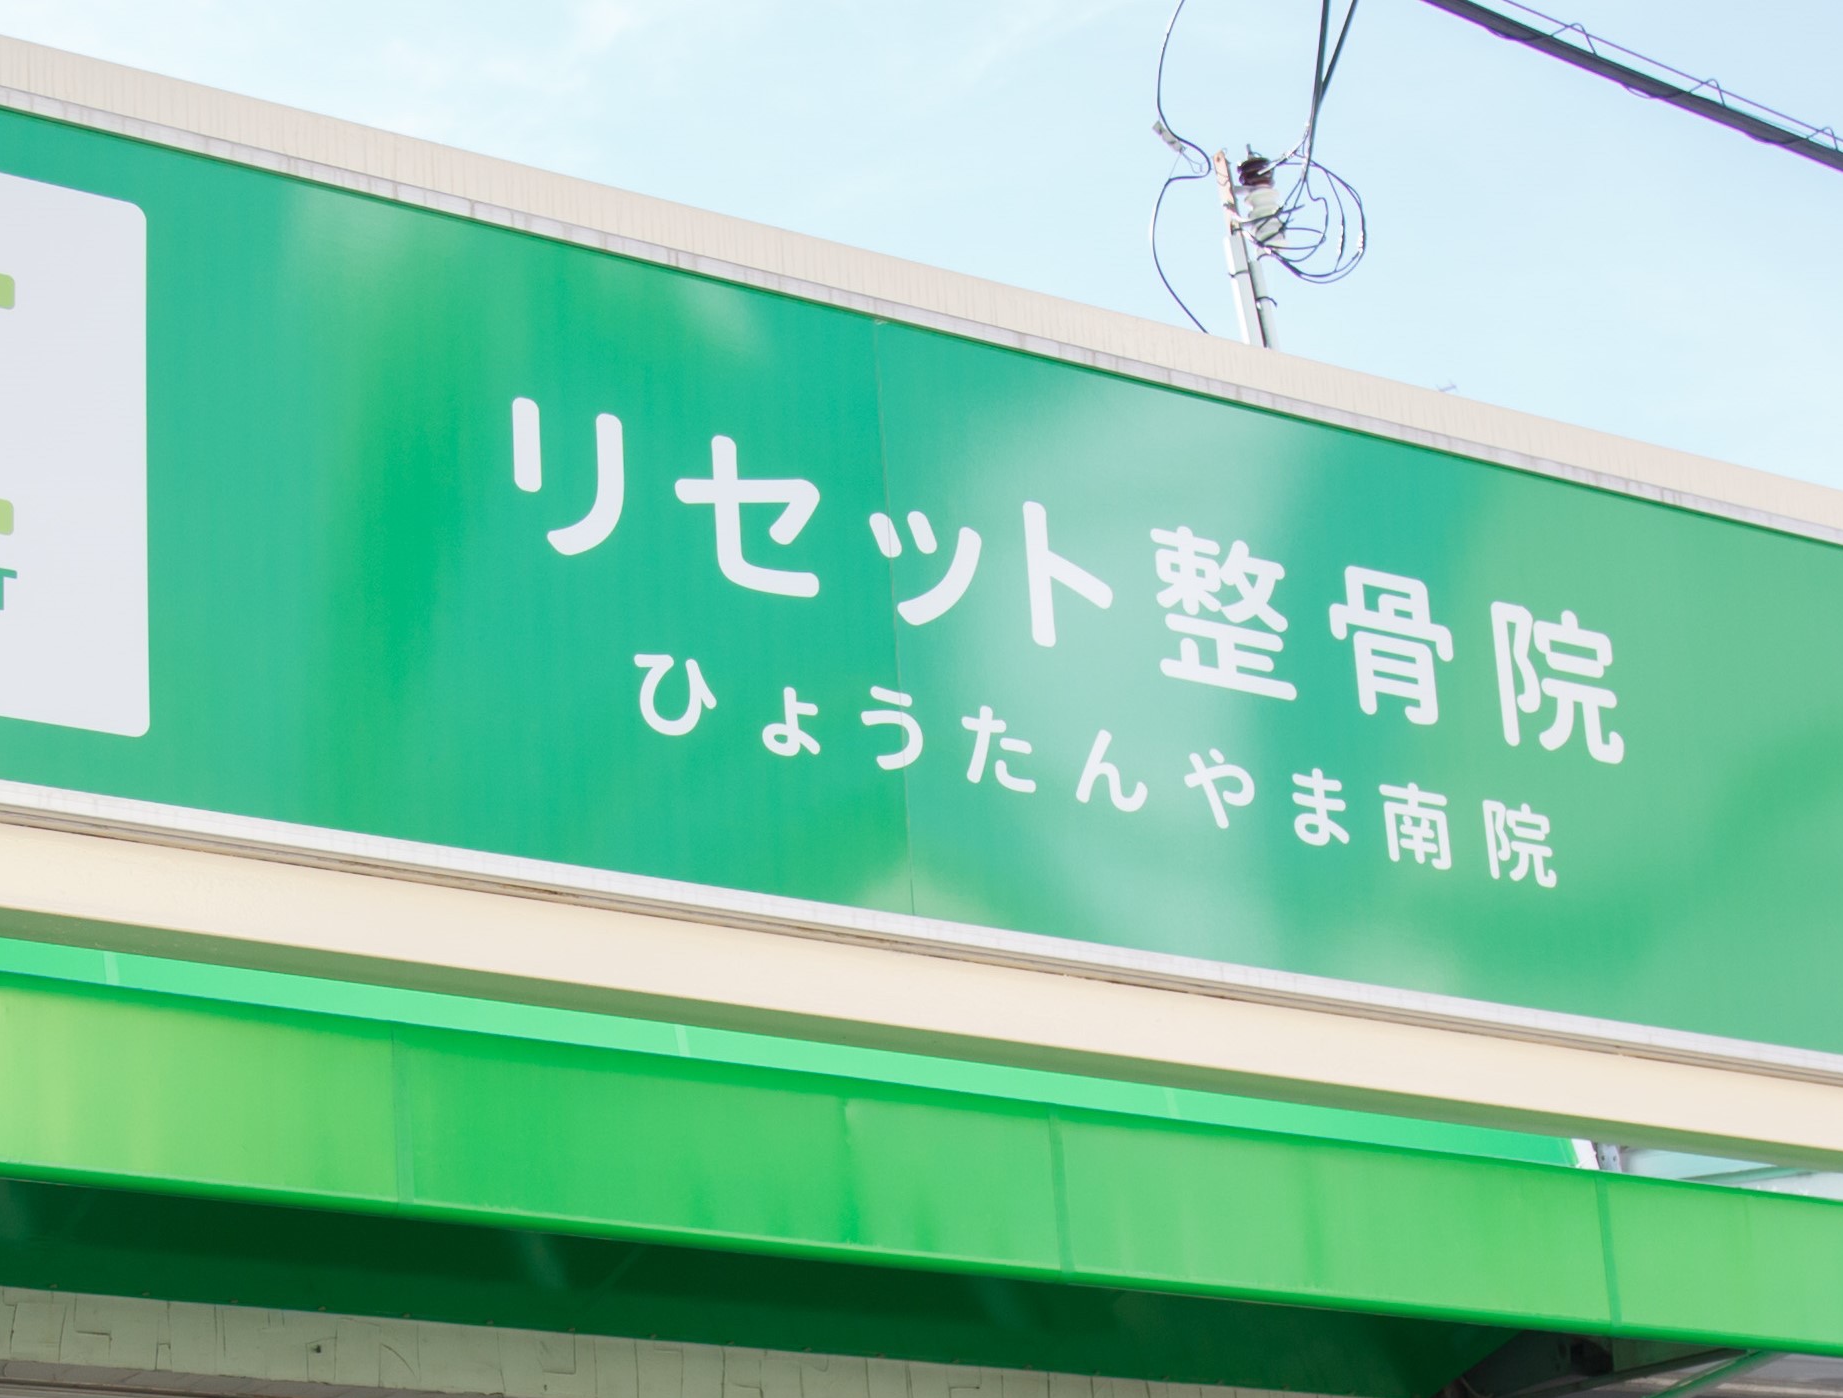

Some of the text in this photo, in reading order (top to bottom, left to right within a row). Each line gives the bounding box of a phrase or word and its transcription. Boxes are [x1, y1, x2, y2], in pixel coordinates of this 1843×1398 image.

[512, 397, 1625, 765] リセット整骨院
[633, 653, 1558, 889] ひょうたんやま南院
